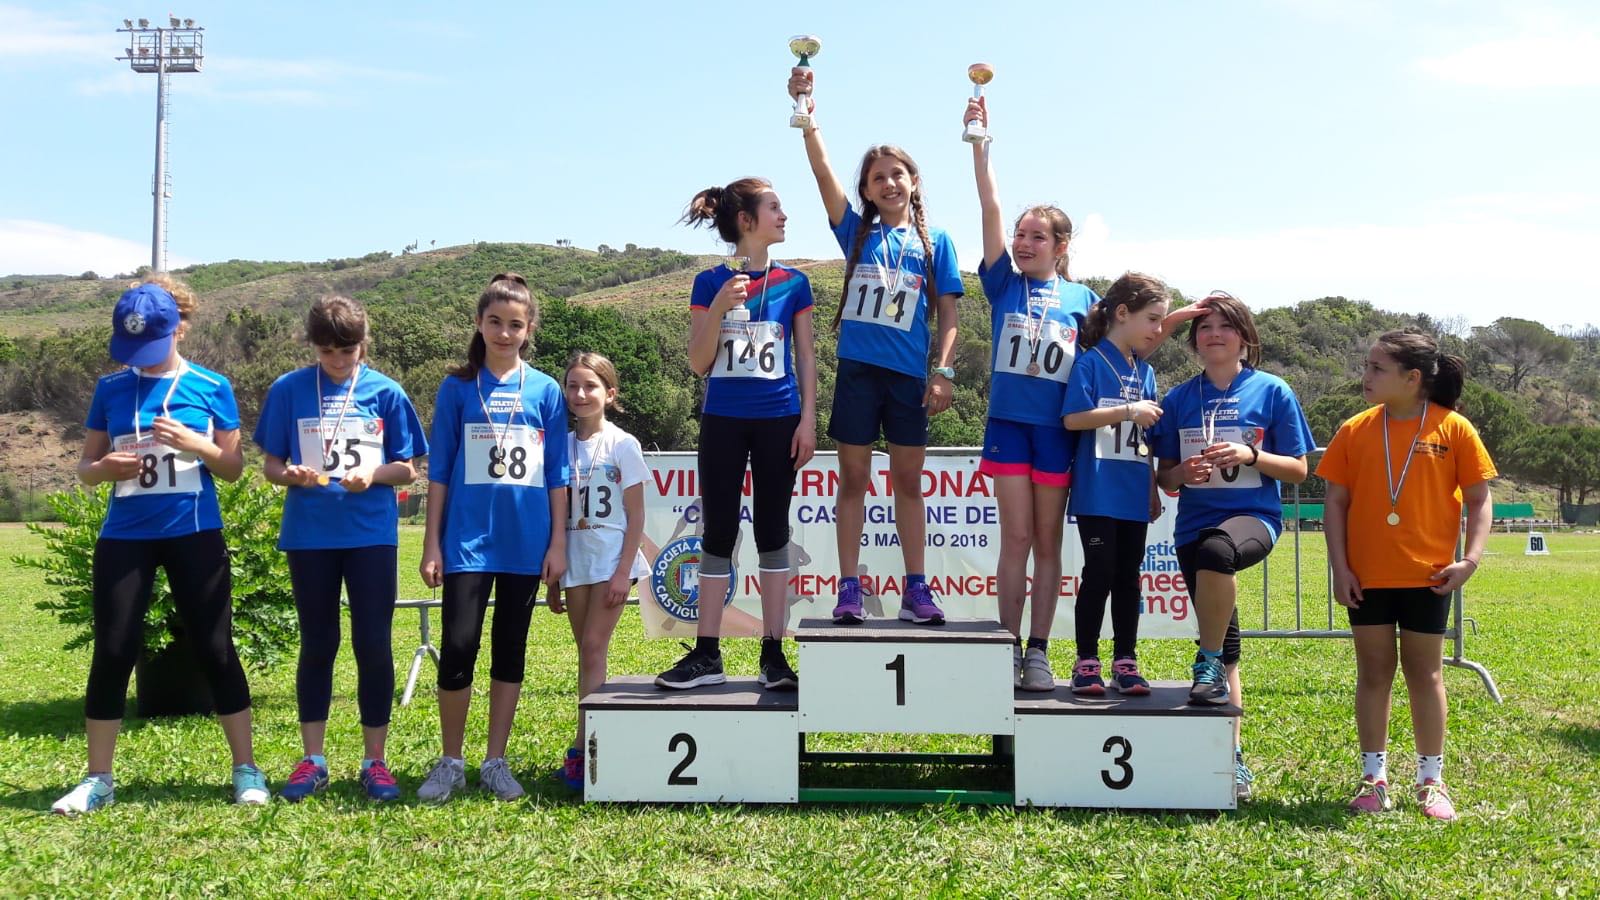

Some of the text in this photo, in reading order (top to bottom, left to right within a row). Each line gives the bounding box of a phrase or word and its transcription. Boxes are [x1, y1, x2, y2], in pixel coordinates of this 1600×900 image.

[857, 284, 907, 323] 114
[723, 339, 775, 373] 146
[1009, 335, 1064, 374] 110
[139, 453, 176, 488] 81
[487, 445, 527, 479] 88
[950, 534, 988, 548] 2018
[1530, 536, 1544, 551] 60
[886, 653, 906, 707] 1
[667, 732, 698, 786] 2
[1100, 735, 1134, 790] 3
